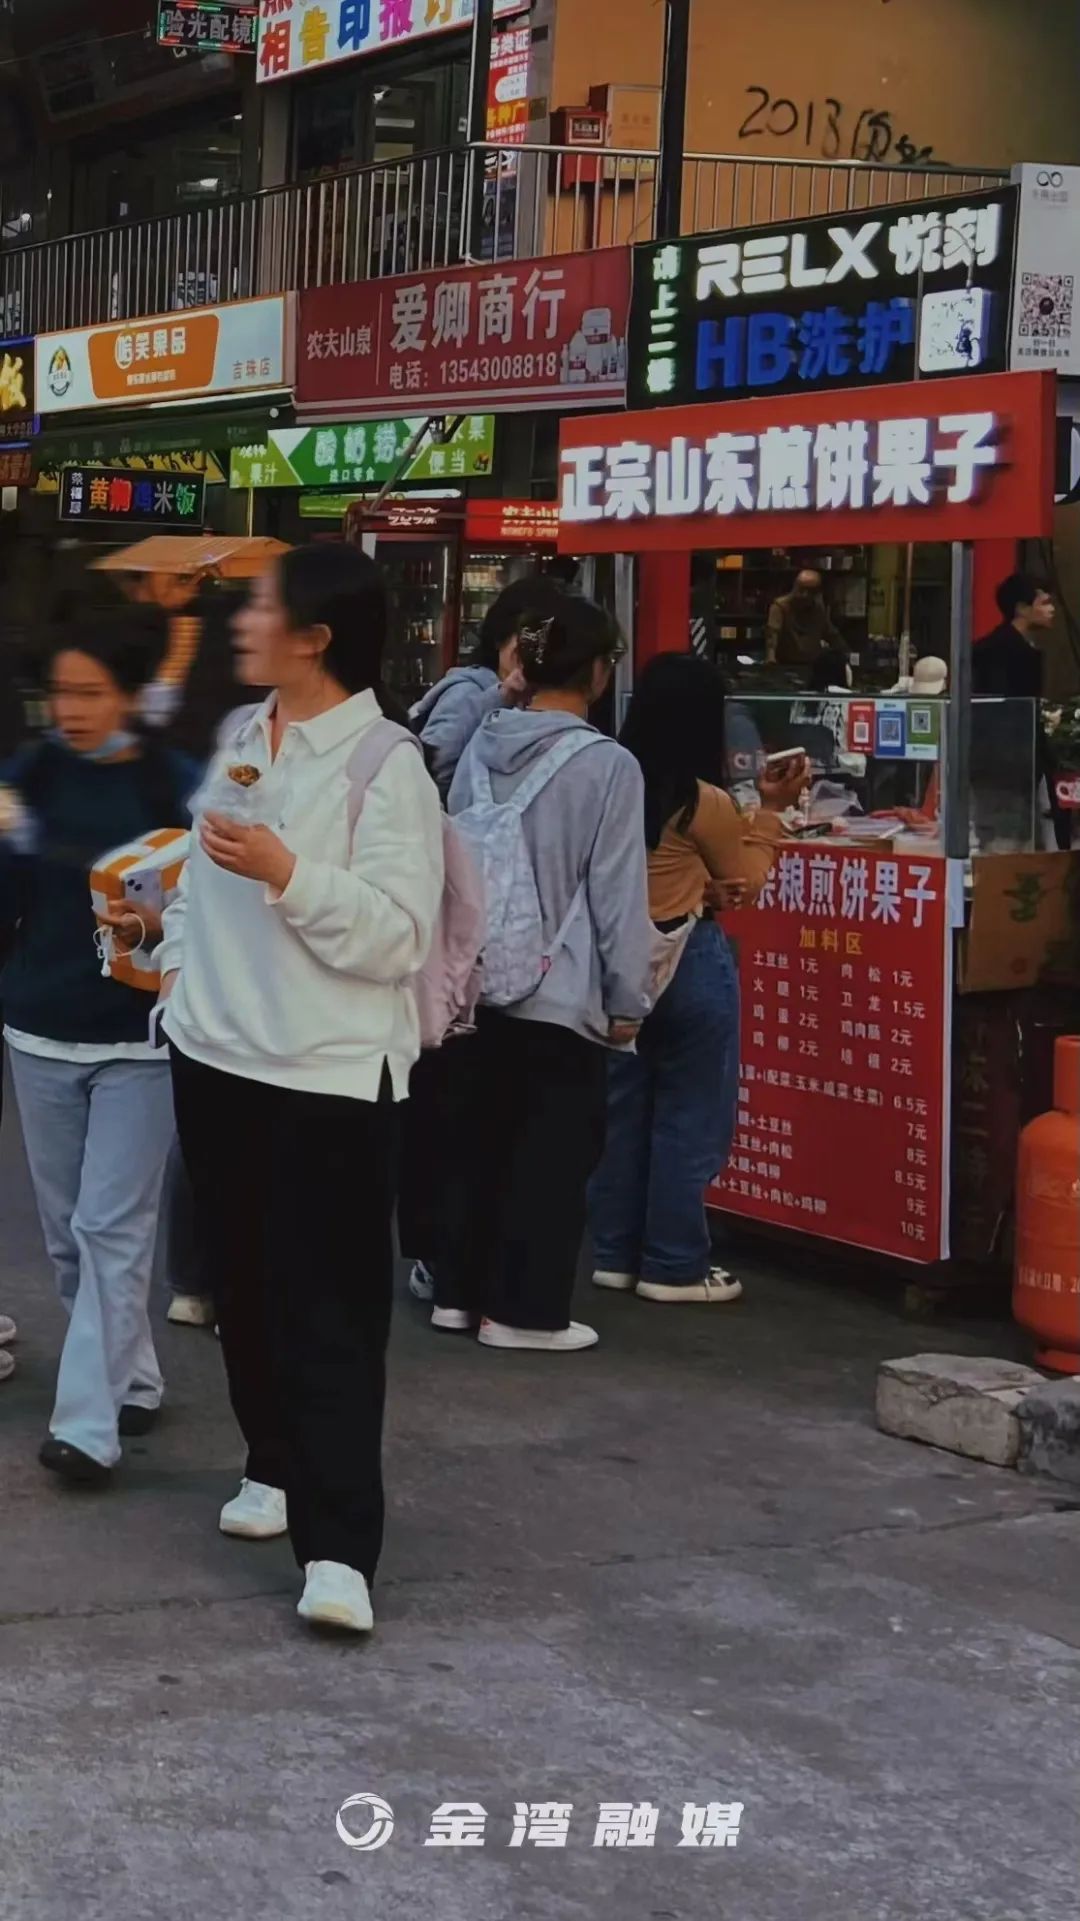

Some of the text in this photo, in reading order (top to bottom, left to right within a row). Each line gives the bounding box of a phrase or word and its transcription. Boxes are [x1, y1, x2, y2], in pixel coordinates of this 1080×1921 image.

[166, 10, 251, 44] 验光配镜
[696, 203, 1002, 300] RELX 悦刻
[389, 267, 566, 353] 爱卿商行
[307, 324, 372, 360] 农夫山泉
[440, 352, 557, 384] 13543008818
[429, 448, 466, 475] 便当
[559, 410, 1001, 521] 正宗山东煎饼果子
[799, 925, 864, 955] 加料区
[800, 958, 819, 974] 1元
[892, 971, 914, 988] 1元
[800, 985, 819, 1001] 1元
[841, 991, 881, 1012] 卫龙
[892, 1000, 926, 1019] 1.5元
[799, 1013, 819, 1029] 2元
[891, 1029, 913, 1046] 2元
[799, 1040, 819, 1056] 2元
[891, 1058, 913, 1075] 2元
[893, 1095, 928, 1116] 6.5元
[907, 1122, 927, 1140] 7元
[907, 1148, 927, 1166] 8元
[894, 1169, 927, 1191] 8.5元
[906, 1198, 927, 1216] 9元
[900, 1220, 926, 1241] 10元
